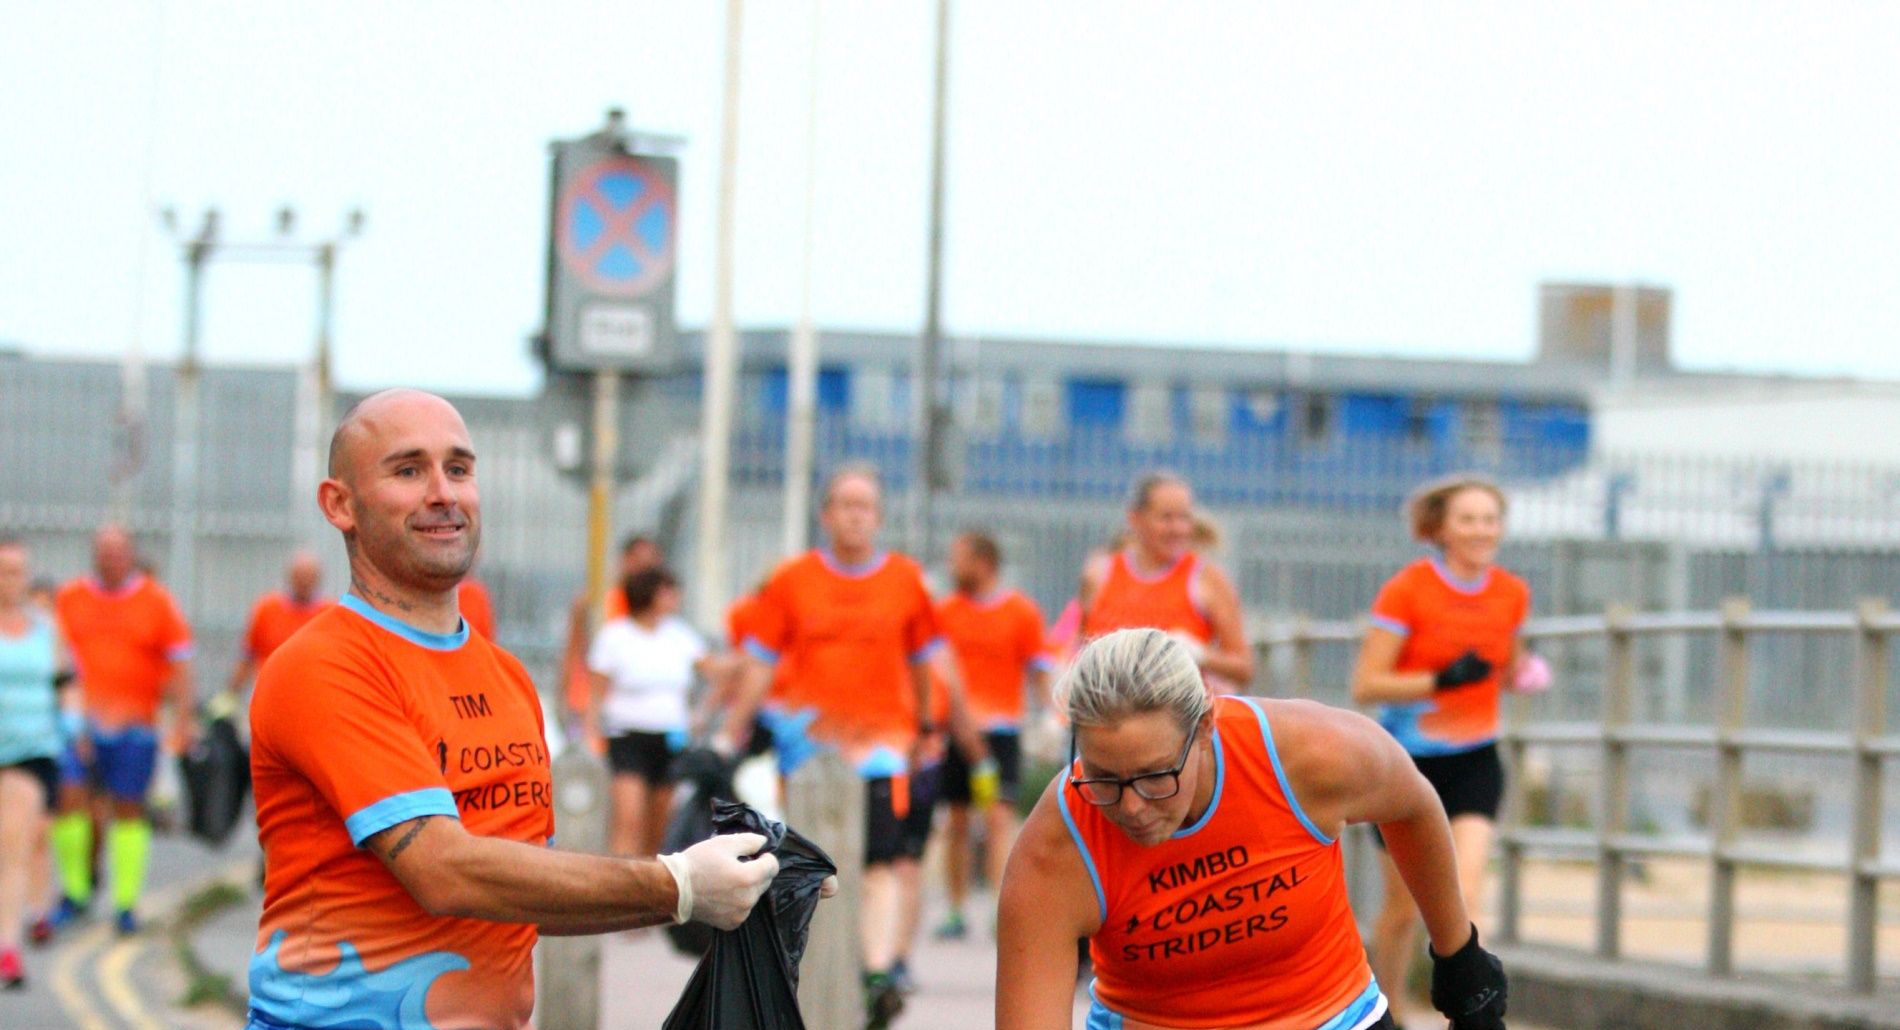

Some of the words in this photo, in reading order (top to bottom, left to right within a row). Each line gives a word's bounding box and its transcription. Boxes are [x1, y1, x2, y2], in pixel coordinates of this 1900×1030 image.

[449, 692, 492, 720] TIM
[1147, 844, 1249, 893] KIMBO
[1152, 865, 1309, 931] COASTAL
[1122, 904, 1289, 962] STRIDERS
